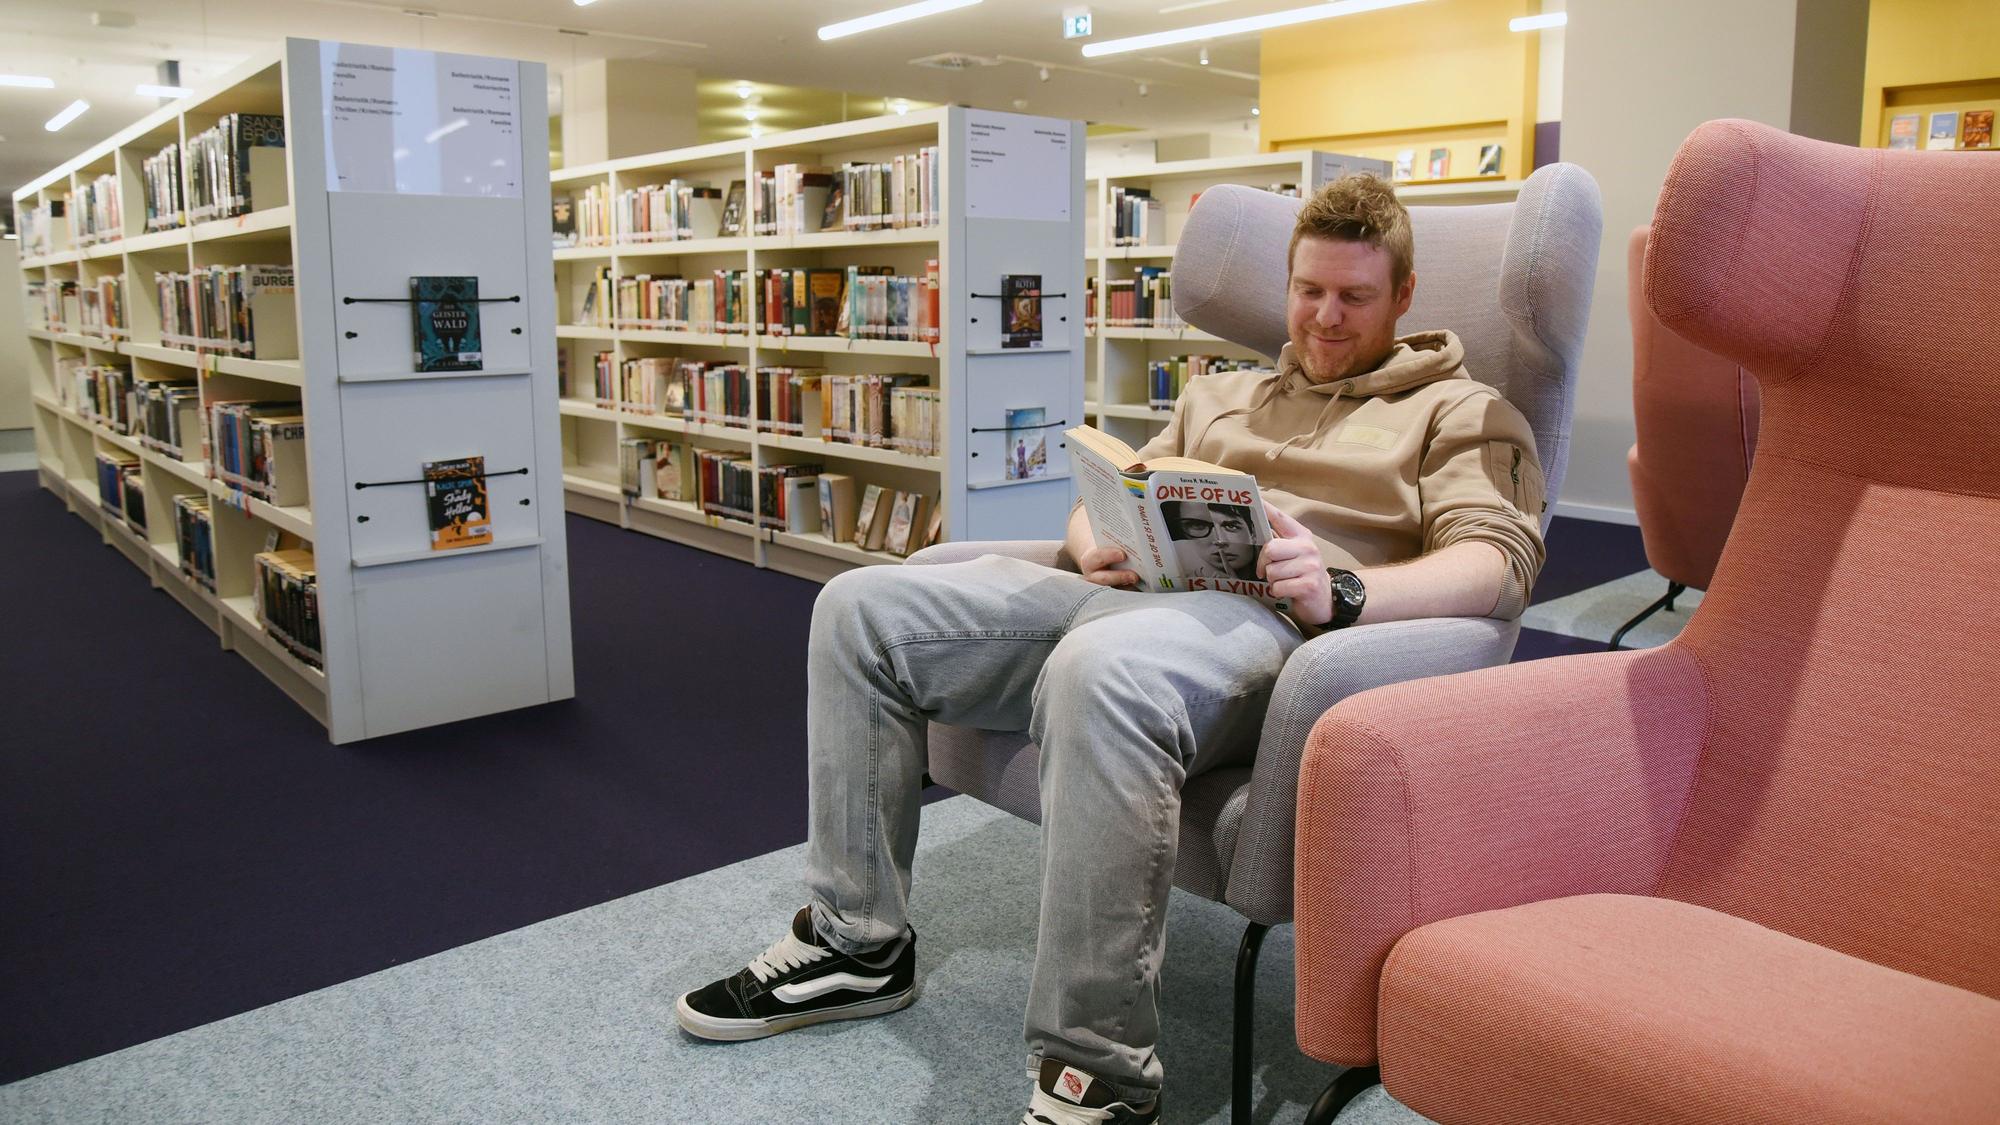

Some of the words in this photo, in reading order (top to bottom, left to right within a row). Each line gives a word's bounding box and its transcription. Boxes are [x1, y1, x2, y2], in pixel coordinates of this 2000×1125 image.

[432, 311, 467, 319] GEISTER
[433, 319, 468, 329] WALD
[444, 489, 472, 506] Shady
[1156, 485, 1197, 500] ONE
[1200, 487, 1225, 502] OF
[1227, 489, 1253, 505] US
[1187, 578, 1209, 592] IS
